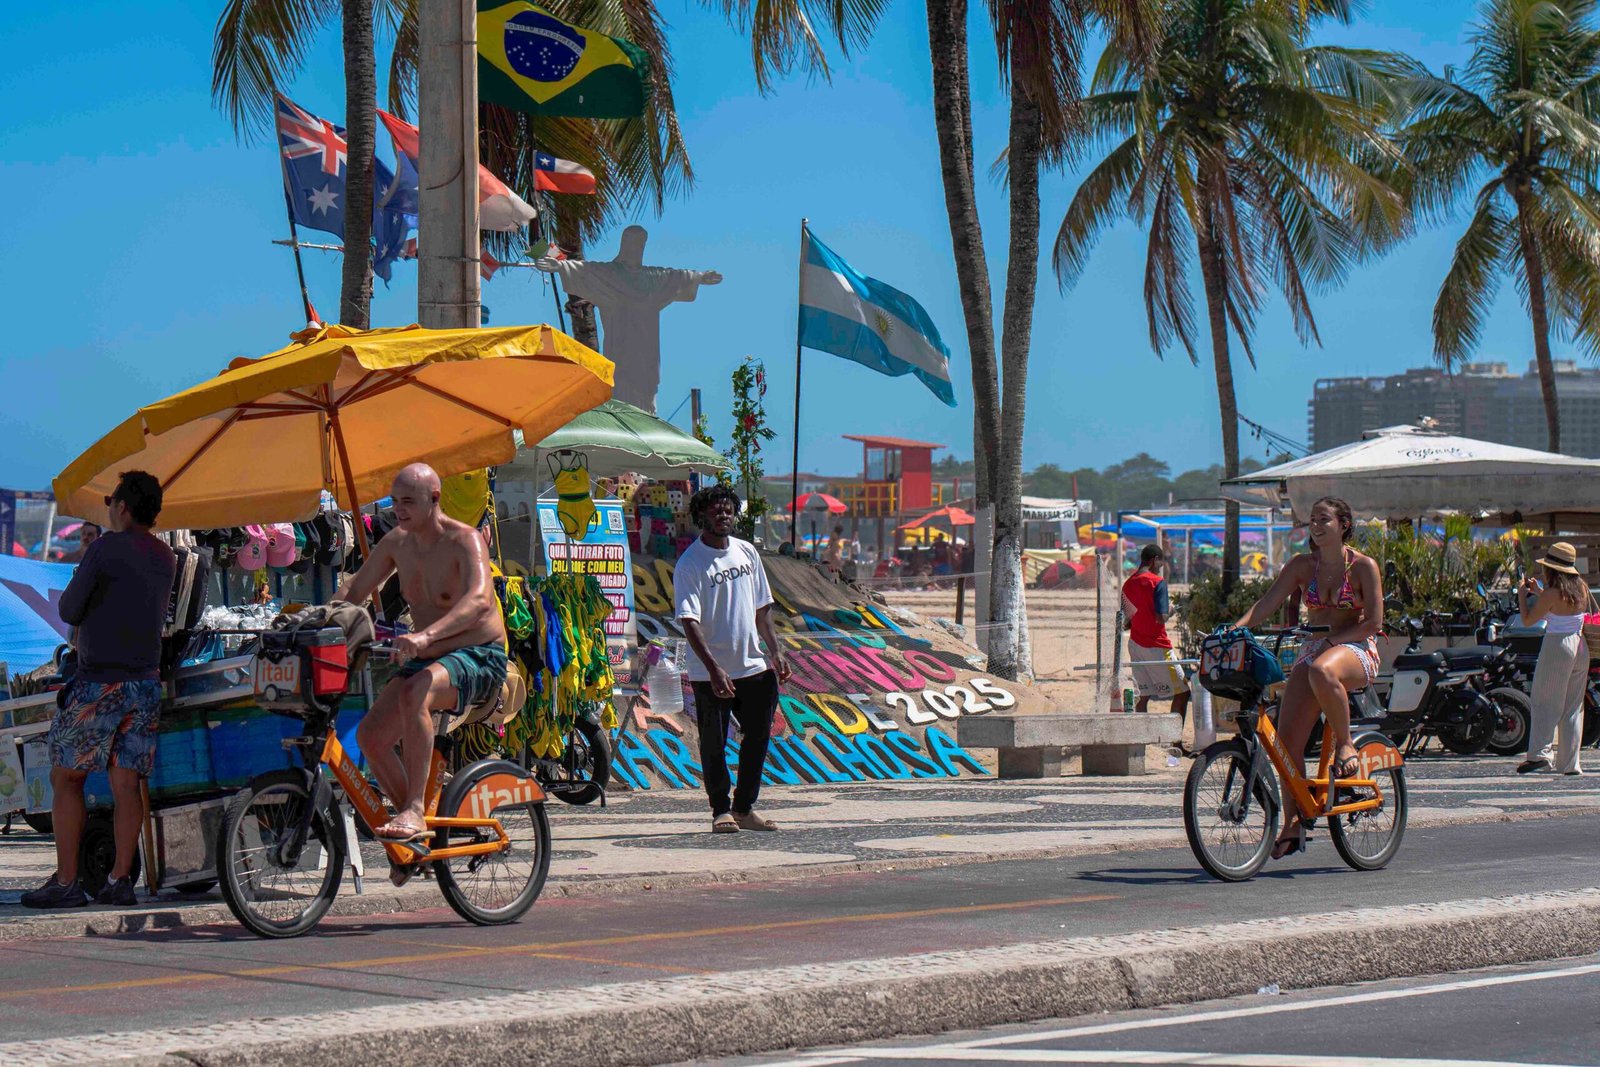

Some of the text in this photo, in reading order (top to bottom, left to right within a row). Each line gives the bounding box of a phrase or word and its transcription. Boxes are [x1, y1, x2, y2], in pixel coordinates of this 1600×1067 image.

[549, 545, 624, 560] QUADO TIRAR FOTO
[587, 561, 606, 573] COM
[607, 561, 624, 573] MEU
[709, 564, 752, 588] JORDAN
[596, 574, 626, 587] BRIGADO
[773, 604, 933, 651] RASIL
[262, 661, 295, 681] itaú
[885, 678, 1016, 726] 2025
[471, 778, 532, 819] itaú
